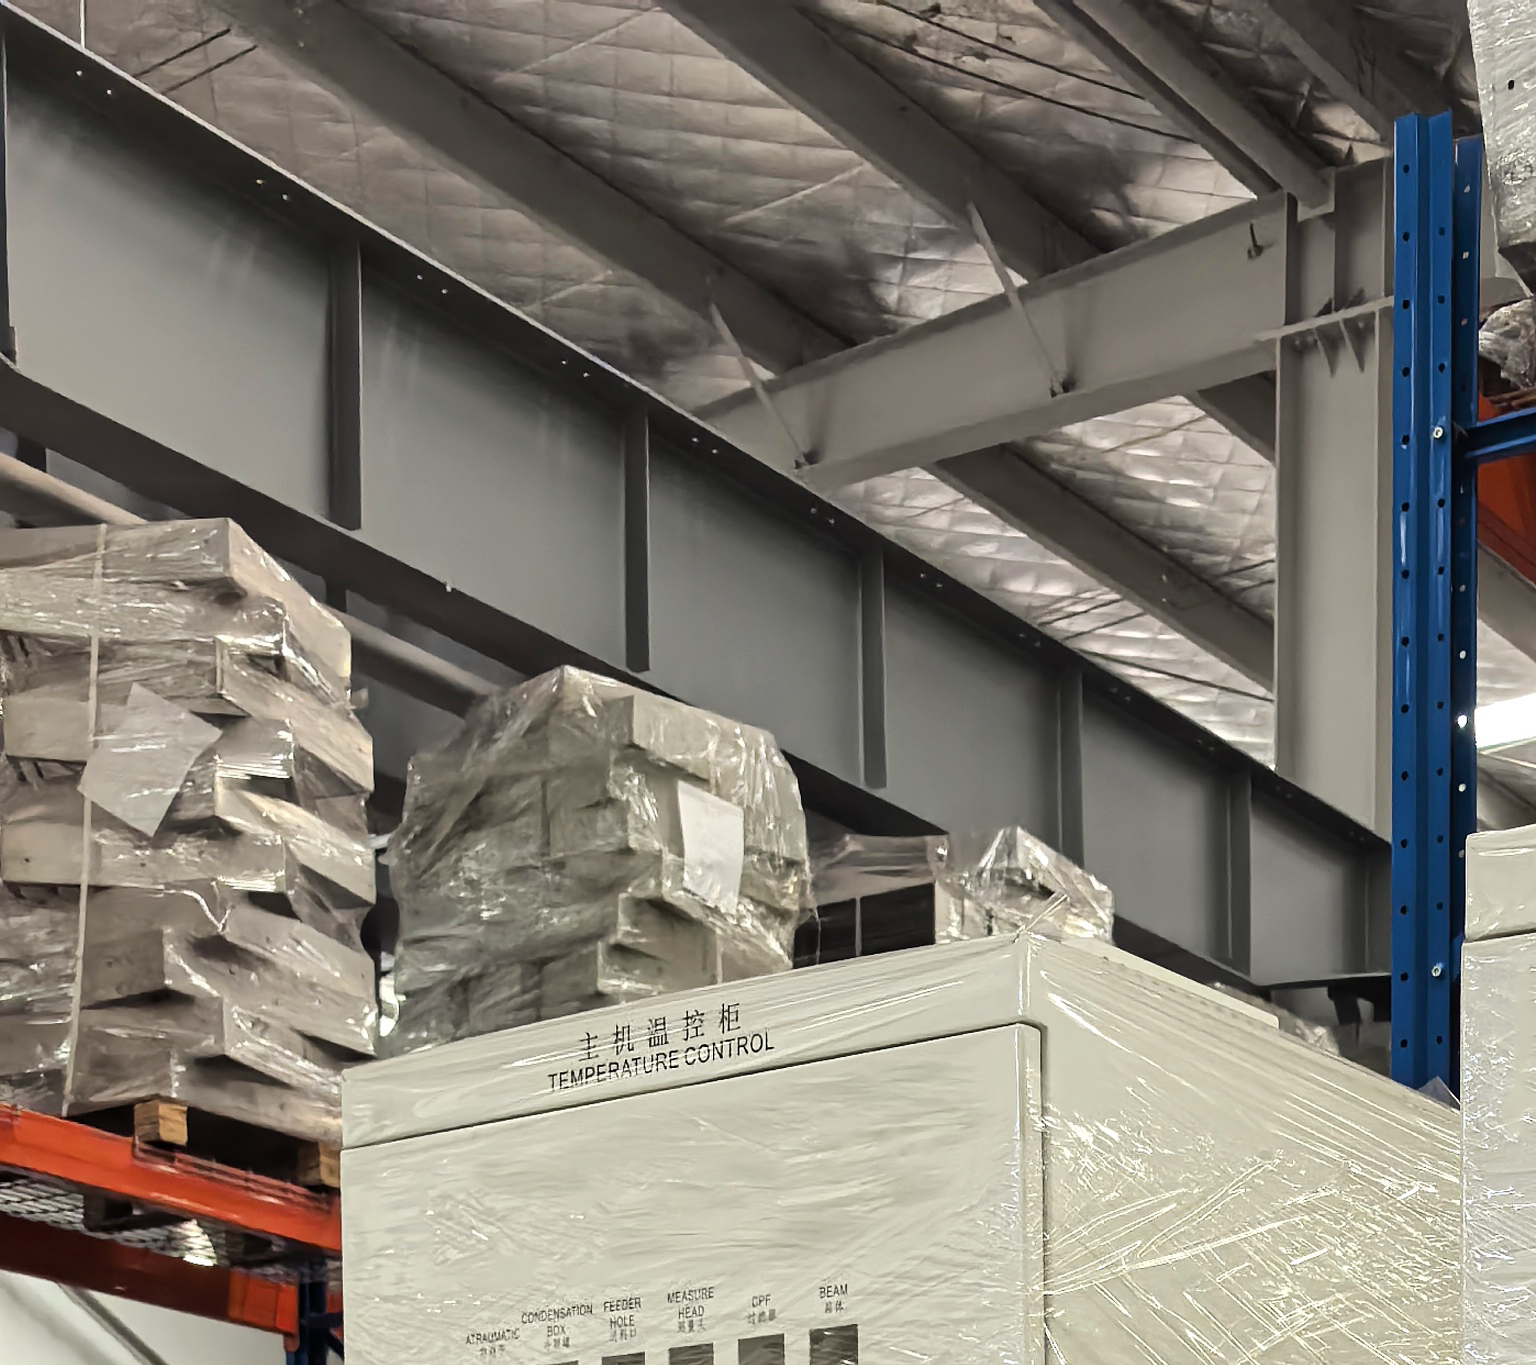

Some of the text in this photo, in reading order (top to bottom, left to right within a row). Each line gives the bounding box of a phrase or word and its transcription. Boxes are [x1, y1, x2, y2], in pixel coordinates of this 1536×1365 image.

[578, 1002, 742, 1062] 主机温控柜
[548, 1030, 775, 1093] TEMPERATURE CONTROL
[667, 1286, 715, 1303] MEASURE
[819, 1283, 848, 1299] BEAM
[603, 1297, 642, 1312] FEEDER
[678, 1305, 705, 1319] HEAD
[521, 1303, 593, 1324] CONDENSATION
[610, 1314, 635, 1329] HOLE
[547, 1325, 567, 1337] BOX
